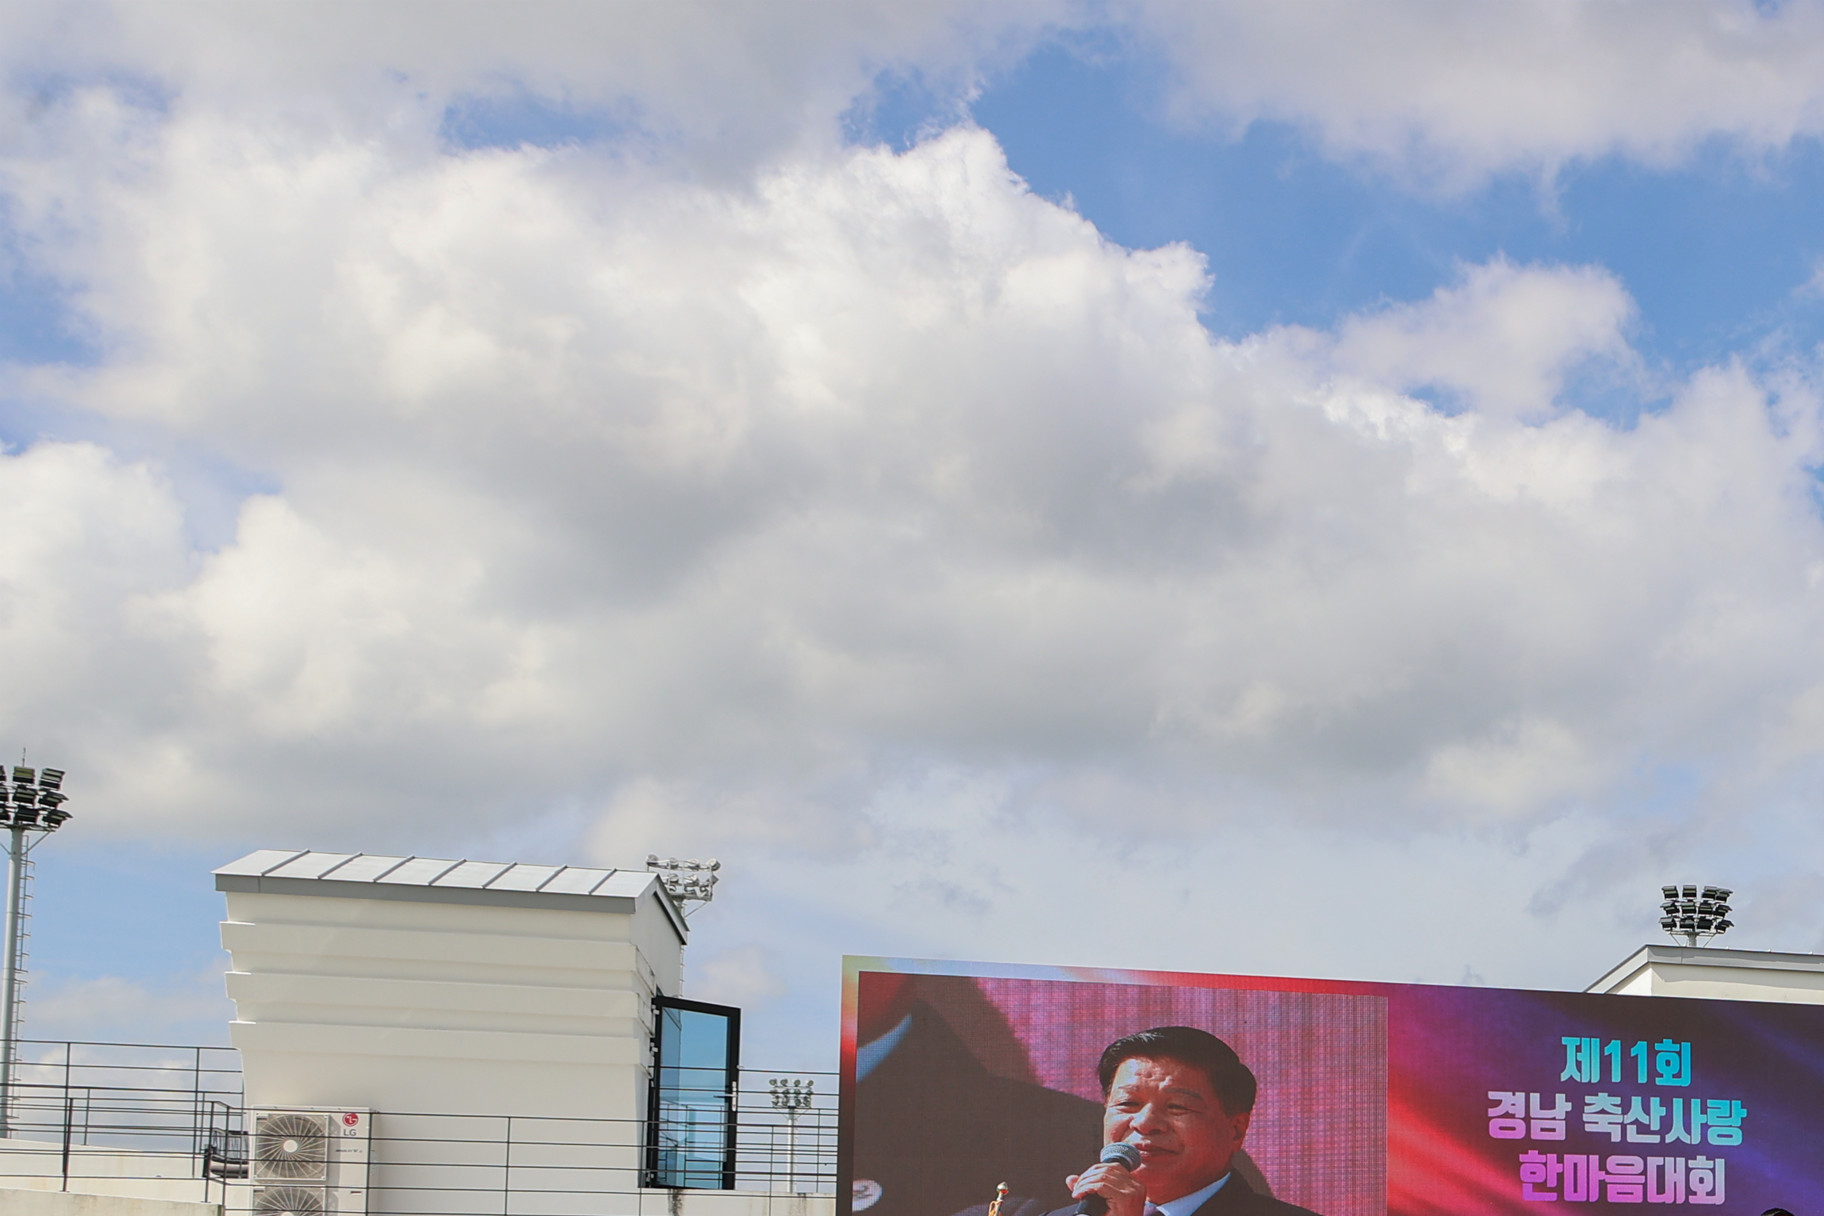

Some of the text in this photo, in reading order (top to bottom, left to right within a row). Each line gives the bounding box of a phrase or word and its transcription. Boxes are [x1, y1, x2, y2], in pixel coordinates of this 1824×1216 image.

[1560, 1036, 1692, 1087] 제11회
[343, 1128, 357, 1137] LG
[1487, 1090, 1748, 1146] 경남 축산사랑
[1518, 1150, 1726, 1205] 한마음대회
